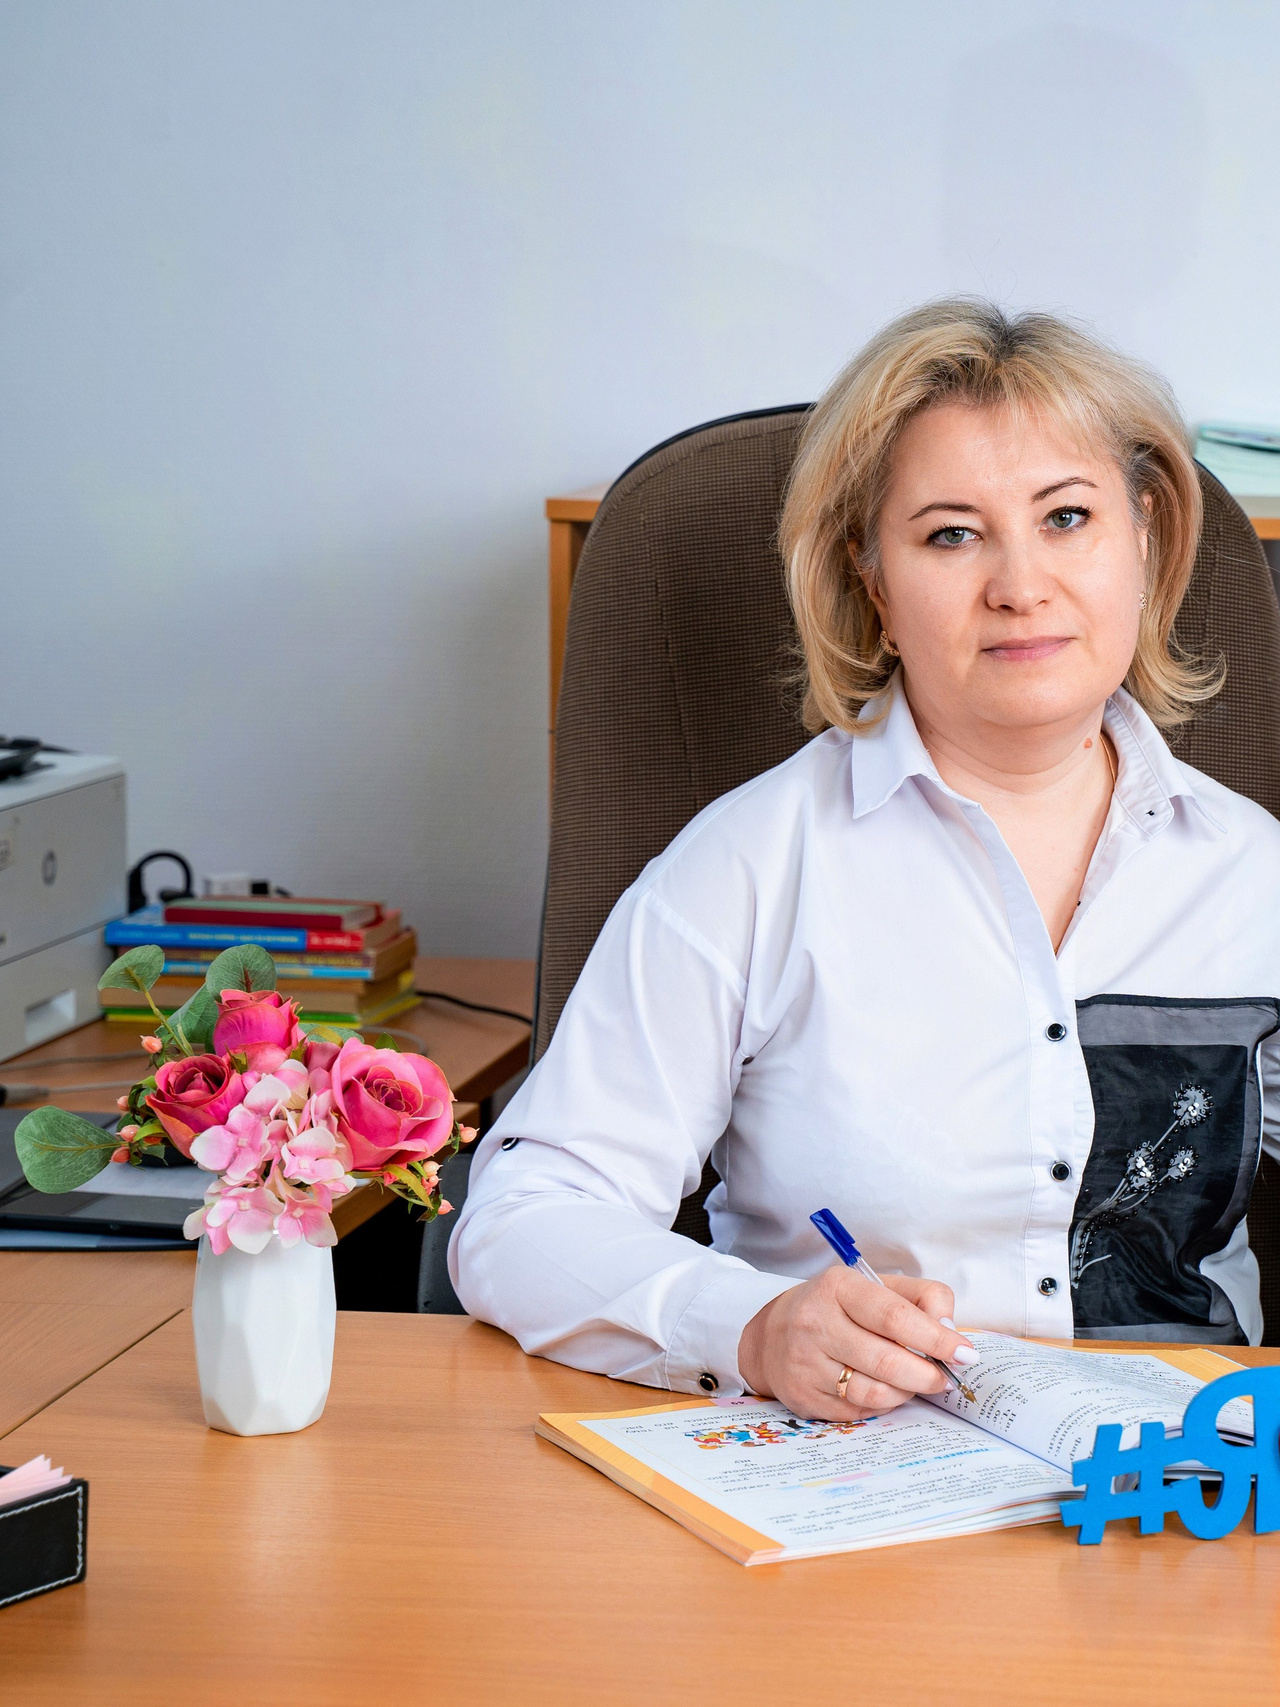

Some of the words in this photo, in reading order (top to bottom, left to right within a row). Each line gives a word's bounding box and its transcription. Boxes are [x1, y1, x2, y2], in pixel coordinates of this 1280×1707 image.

[684, 1411, 767, 1423] Подготовьтесь
[934, 1448, 989, 1459] ПРОВЕРЬ
[898, 1460, 927, 1468] СЕБЯ
